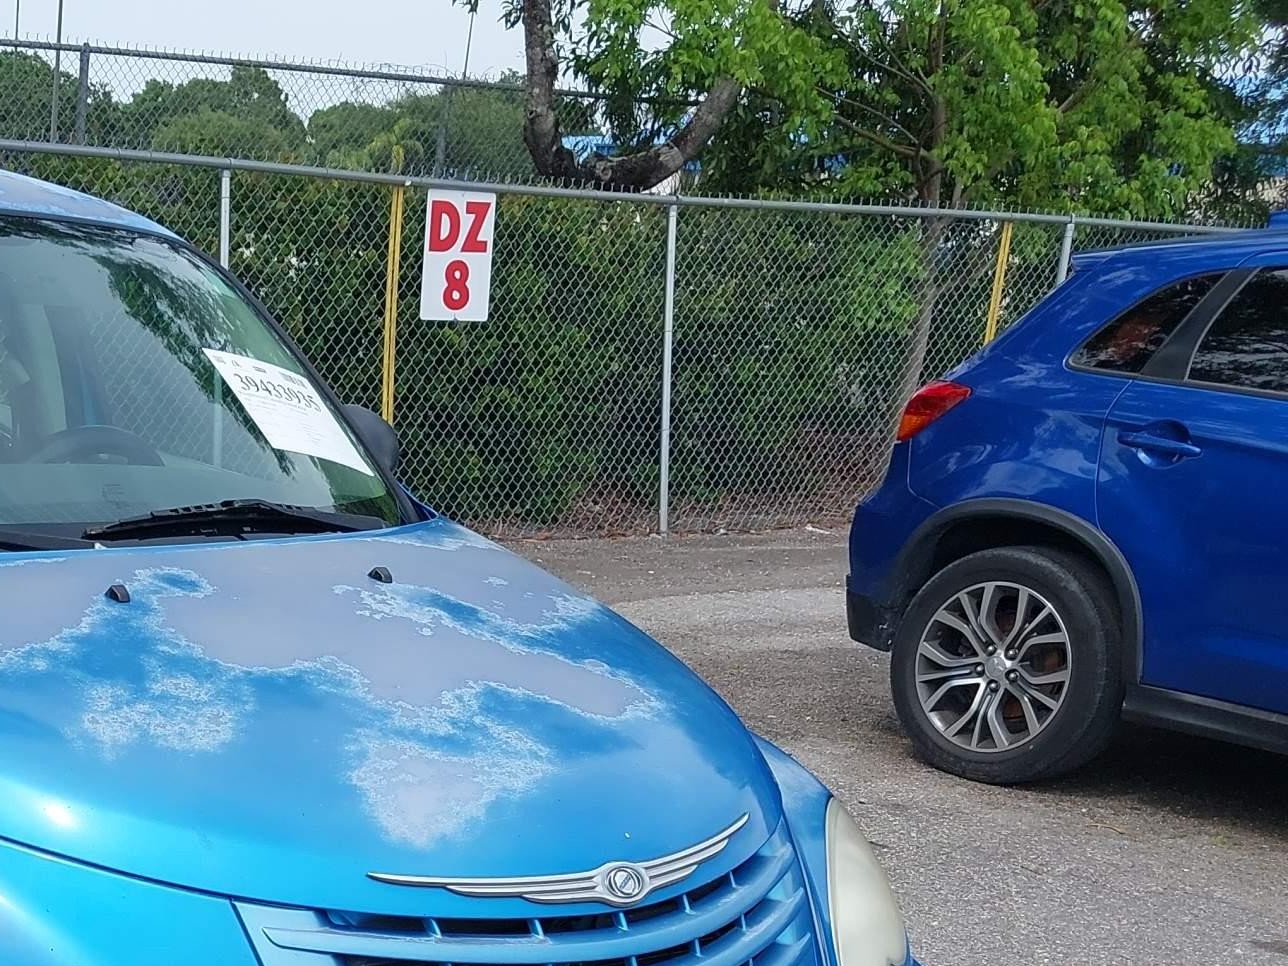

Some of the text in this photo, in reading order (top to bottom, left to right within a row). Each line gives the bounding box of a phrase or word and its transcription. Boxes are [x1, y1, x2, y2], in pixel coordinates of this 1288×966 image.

[429, 200, 491, 253] DZ
[442, 260, 469, 310] 8
[233, 373, 322, 413] 39433935
